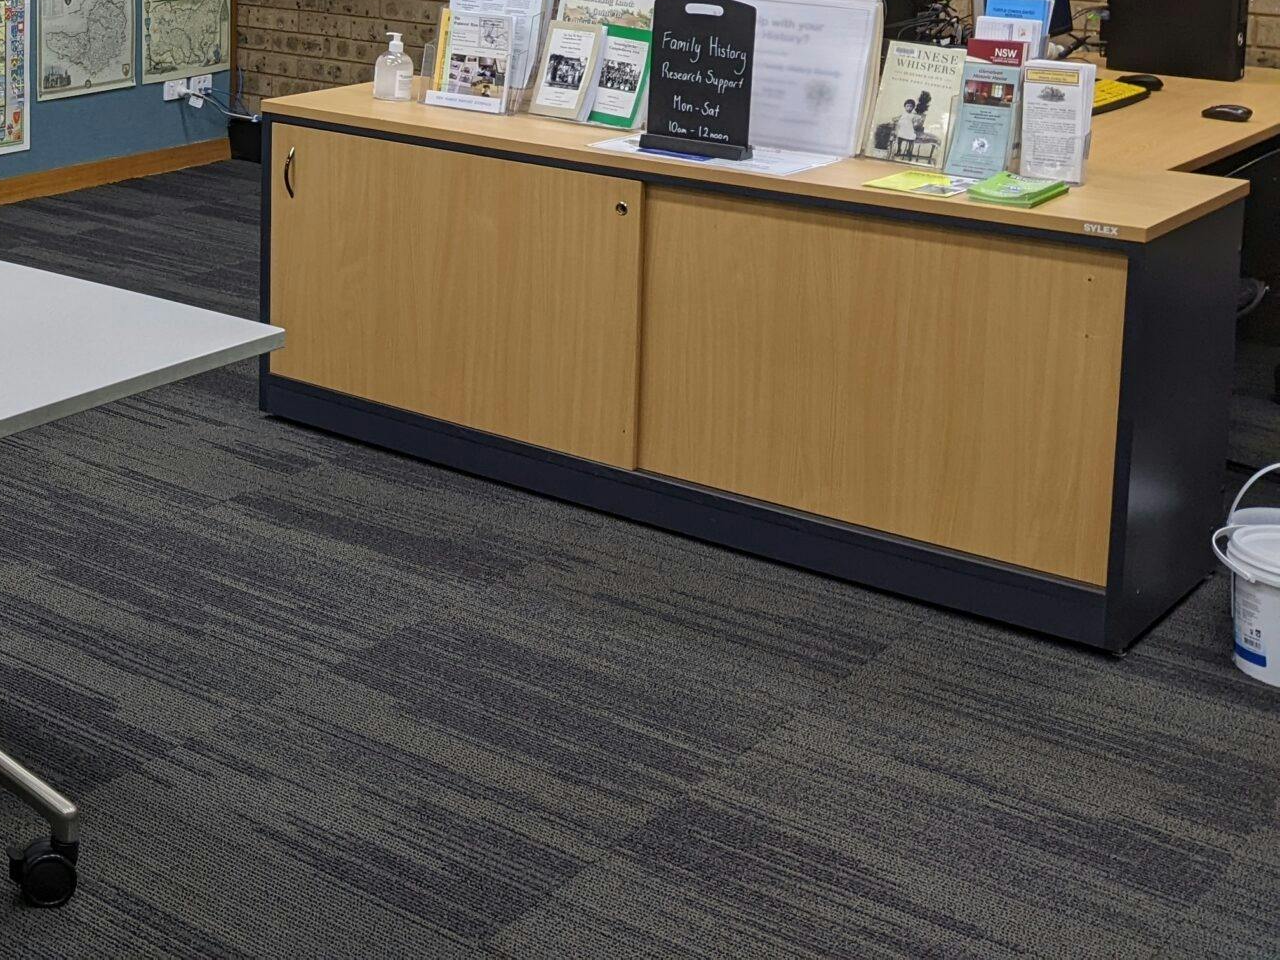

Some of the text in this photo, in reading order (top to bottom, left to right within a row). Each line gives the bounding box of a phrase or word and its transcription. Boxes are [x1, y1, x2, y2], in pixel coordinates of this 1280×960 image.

[772, 18, 824, 32] with your
[662, 31, 701, 63] Family
[710, 36, 746, 75] History
[994, 48, 1018, 58] NSW
[897, 58, 956, 75] WHISPERS
[662, 62, 702, 82] Research
[706, 70, 744, 94] Support
[673, 94, 692, 112] Mon
[701, 102, 720, 118] Sat
[668, 120, 687, 134] 10am
[1084, 222, 1118, 236] SYLEX
